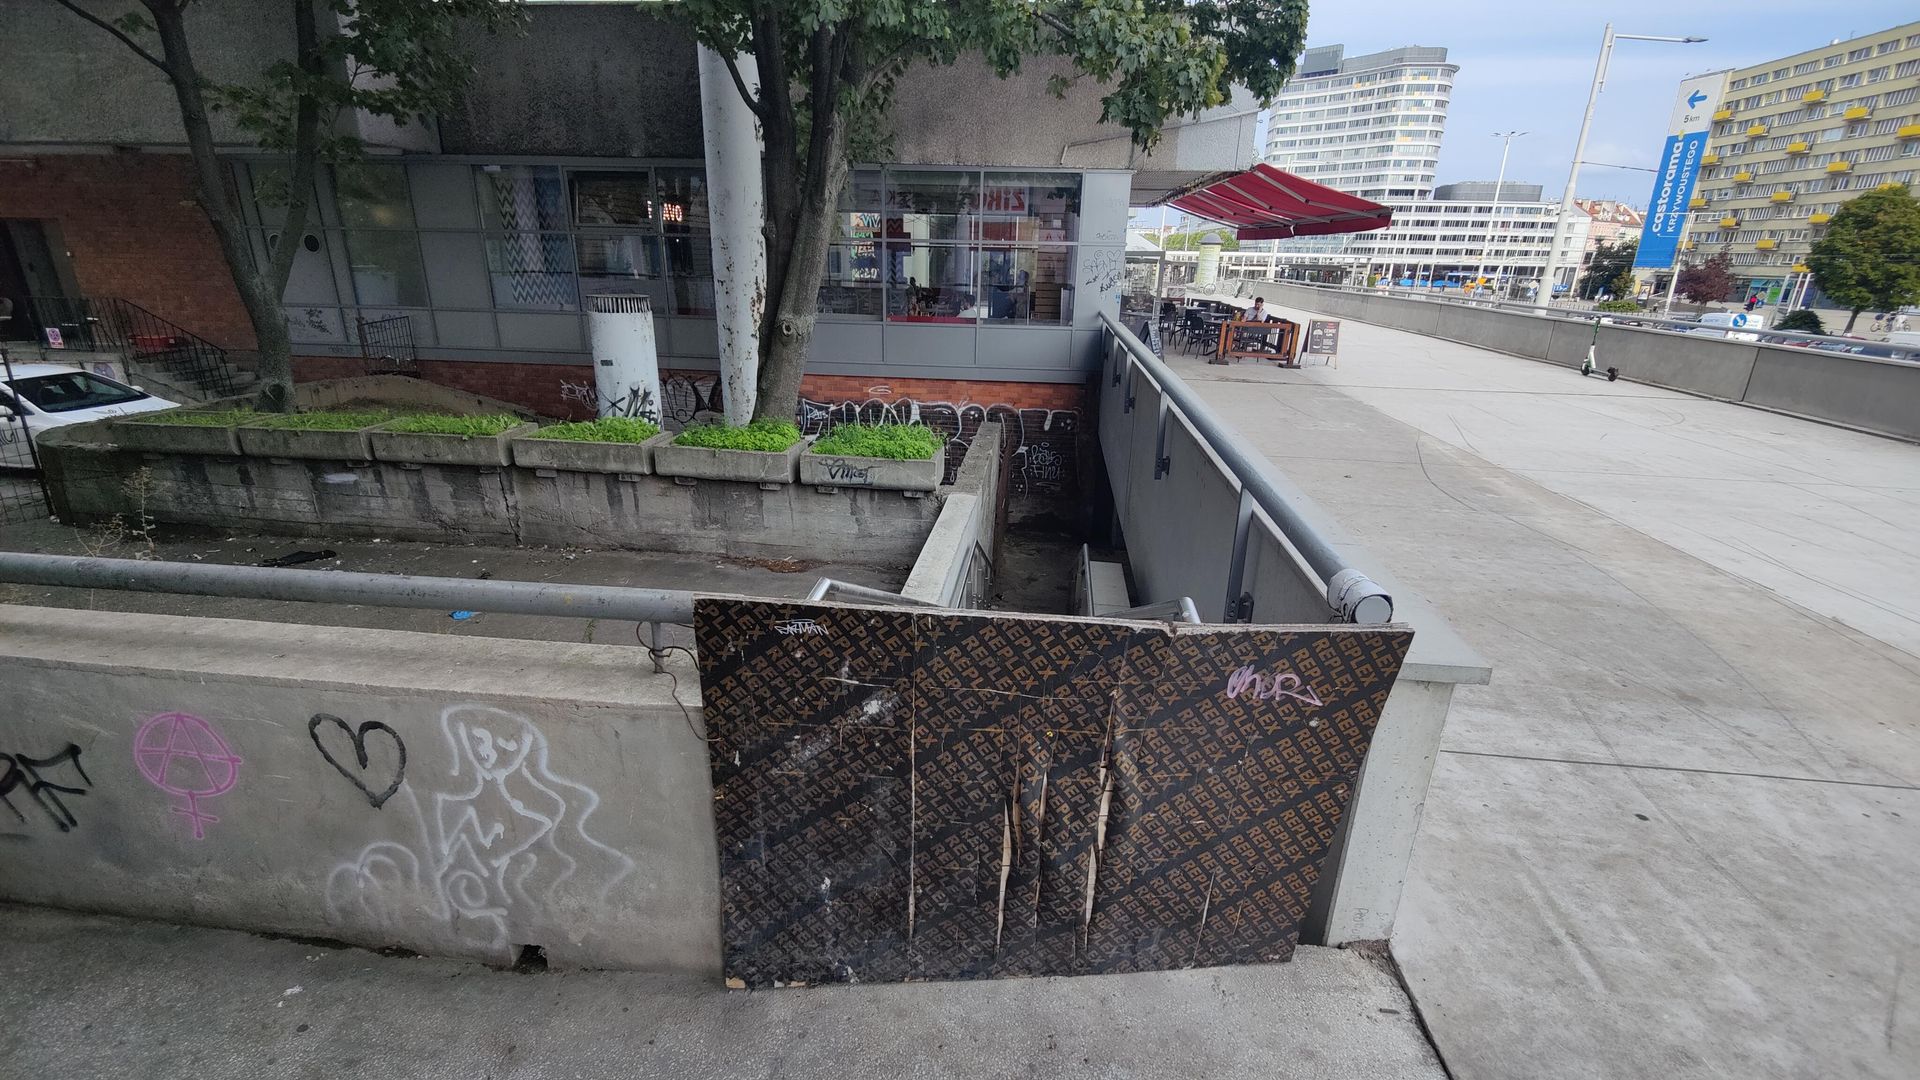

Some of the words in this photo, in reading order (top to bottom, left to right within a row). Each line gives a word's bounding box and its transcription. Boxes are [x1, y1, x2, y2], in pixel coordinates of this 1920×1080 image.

[1684, 114, 1690, 123] 5
[1689, 114, 1700, 122] km
[1652, 141, 1684, 233] castorama
[1667, 140, 1698, 232] KRZYWOUSTEGO
[765, 645, 833, 712] REPLEX
[942, 645, 1006, 712] REPLEX
[961, 634, 1024, 703] REPLEX
[977, 624, 1041, 691] REPLEX
[1107, 655, 1166, 716] REPLEX
[1125, 645, 1184, 707] REPLEX
[1145, 635, 1202, 697] REPLEX
[1291, 646, 1340, 707] REPLEX
[1310, 636, 1360, 698] REPLEX
[719, 675, 787, 739] REPLEX
[735, 665, 801, 730] REPLEX
[749, 655, 816, 721] REPLEX
[892, 676, 956, 739] REPLEX
[909, 667, 972, 730] REPLEX
[926, 655, 989, 721] REPLEX
[1140, 726, 1194, 782] REPLEX
[1158, 717, 1211, 773] REPLEX
[1176, 707, 1228, 764] REPLEX
[1194, 698, 1246, 754] REPLEX
[1293, 727, 1340, 781] REPLEX
[1312, 718, 1359, 772] REPLEX
[755, 757, 818, 816] REPLEX
[769, 749, 833, 808] REPLEX
[920, 760, 978, 819] REPLEX
[1221, 764, 1270, 817] REPLEX
[1238, 755, 1287, 809] REPLEX
[1256, 746, 1305, 800] REPLEX
[1274, 737, 1323, 791] REPLEX
[727, 775, 789, 832] REPLEX
[741, 766, 803, 824] REPLEX
[1170, 792, 1219, 842] REPLEX
[1187, 783, 1236, 834] REPLEX
[1204, 774, 1253, 825] REPLEX
[800, 825, 861, 880] REPLEX
[1138, 811, 1186, 858] REPLEX
[1153, 802, 1203, 850] REPLEX
[1245, 825, 1290, 872] REPLEX
[1262, 817, 1307, 864] REPLEX
[1279, 808, 1323, 856] REPLEX
[1165, 867, 1211, 914] REPLEX
[1196, 851, 1242, 897] REPLEX
[1212, 842, 1258, 889] REPLEX
[1119, 893, 1165, 936] REPLEX
[1134, 885, 1181, 929] REPLEX
[1149, 876, 1196, 921] REPLEX
[1236, 897, 1278, 939] REPLEX
[1251, 889, 1294, 931] REPLEX
[1089, 910, 1135, 952] REPLEX
